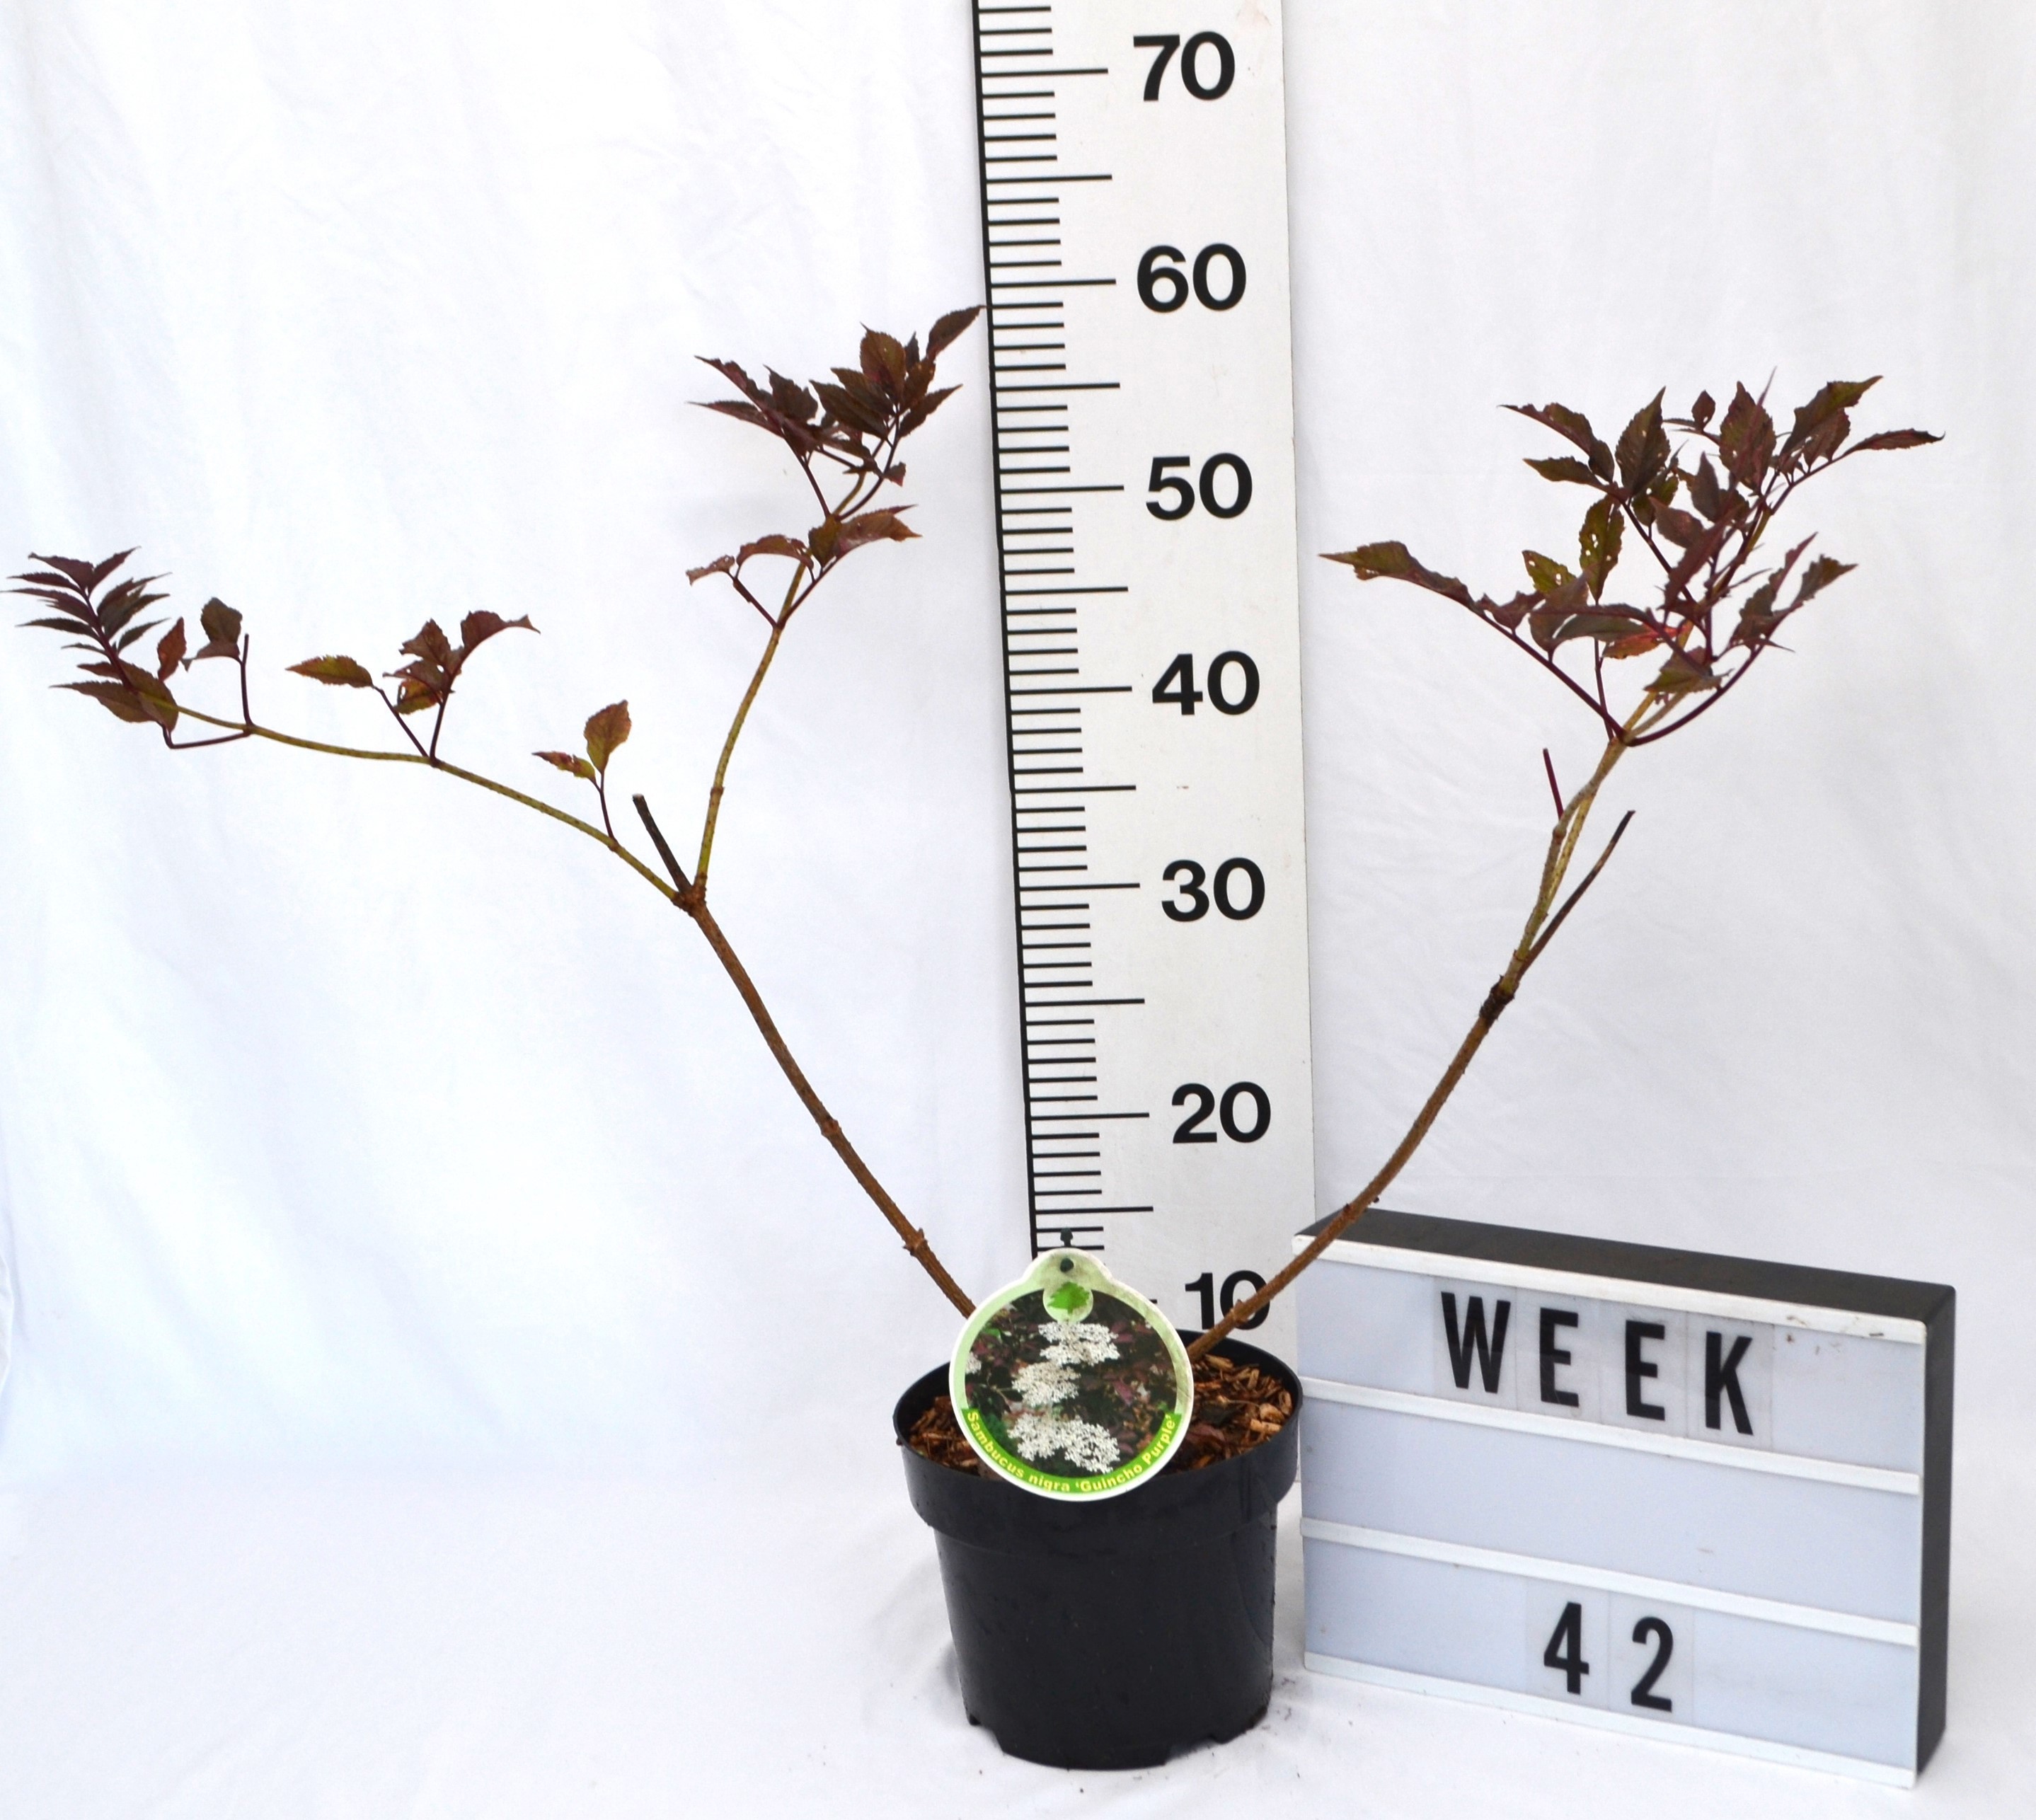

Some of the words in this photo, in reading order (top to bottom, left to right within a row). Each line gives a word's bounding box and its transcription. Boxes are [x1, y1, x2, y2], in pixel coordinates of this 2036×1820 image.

[1133, 31, 1235, 101] 70
[1137, 243, 1246, 313] 60
[1146, 453, 1253, 521] 50
[1152, 650, 1260, 715] 40
[1161, 857, 1265, 922] 30
[1171, 1081, 1271, 1144] 20
[1185, 1270, 1270, 1330] 10
[1441, 1291, 1754, 1435] WEEK
[967, 1411, 1025, 1478] Sambucus
[1028, 1474, 1071, 1492] nigra
[1543, 1601, 1674, 1712] 42
